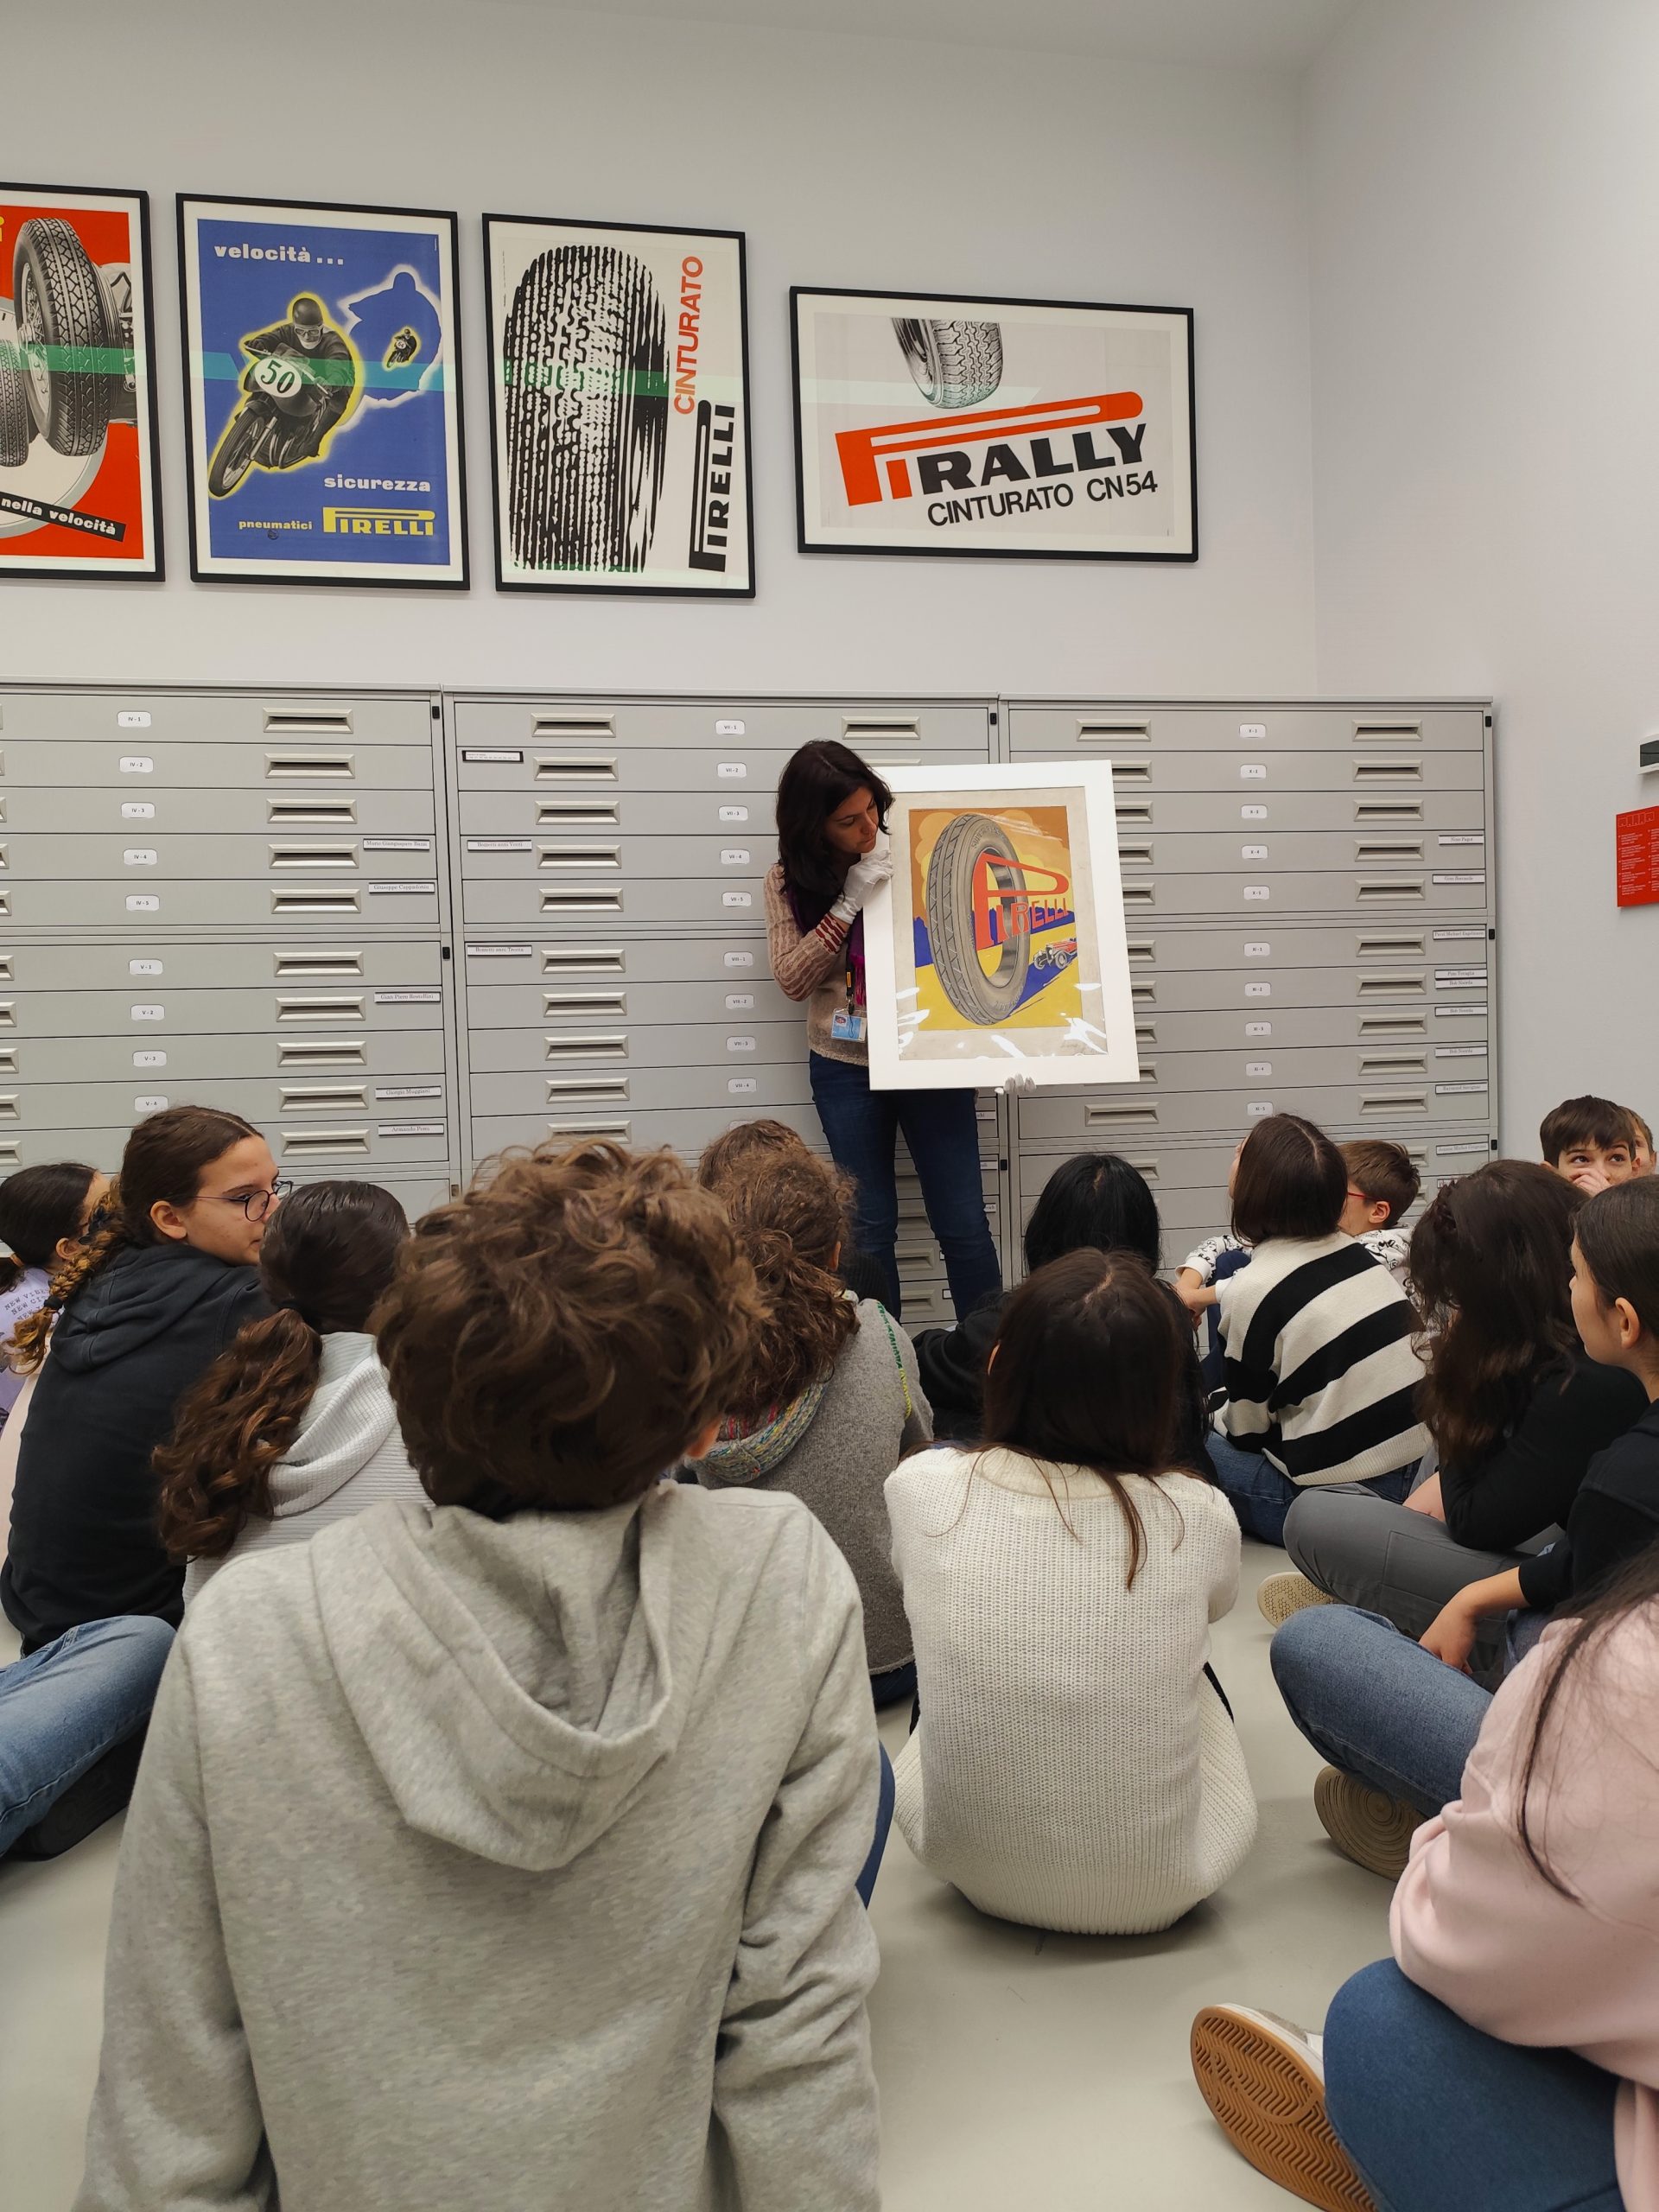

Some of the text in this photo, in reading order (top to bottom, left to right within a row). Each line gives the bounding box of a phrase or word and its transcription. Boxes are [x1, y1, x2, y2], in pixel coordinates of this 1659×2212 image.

[674, 256, 703, 415] CINTURATO
[260, 360, 296, 394] 50
[324, 474, 431, 493] sicurezza
[689, 399, 735, 572] PIRELLI
[1, 498, 117, 535] nella velocità
[238, 506, 435, 536] pneumatici PIRELLI
[927, 483, 1074, 527] CINTURATO
[972, 852, 1070, 950] PIRELLI
[4, 1296, 21, 1311] NEW
[11, 1301, 29, 1315] NEW
